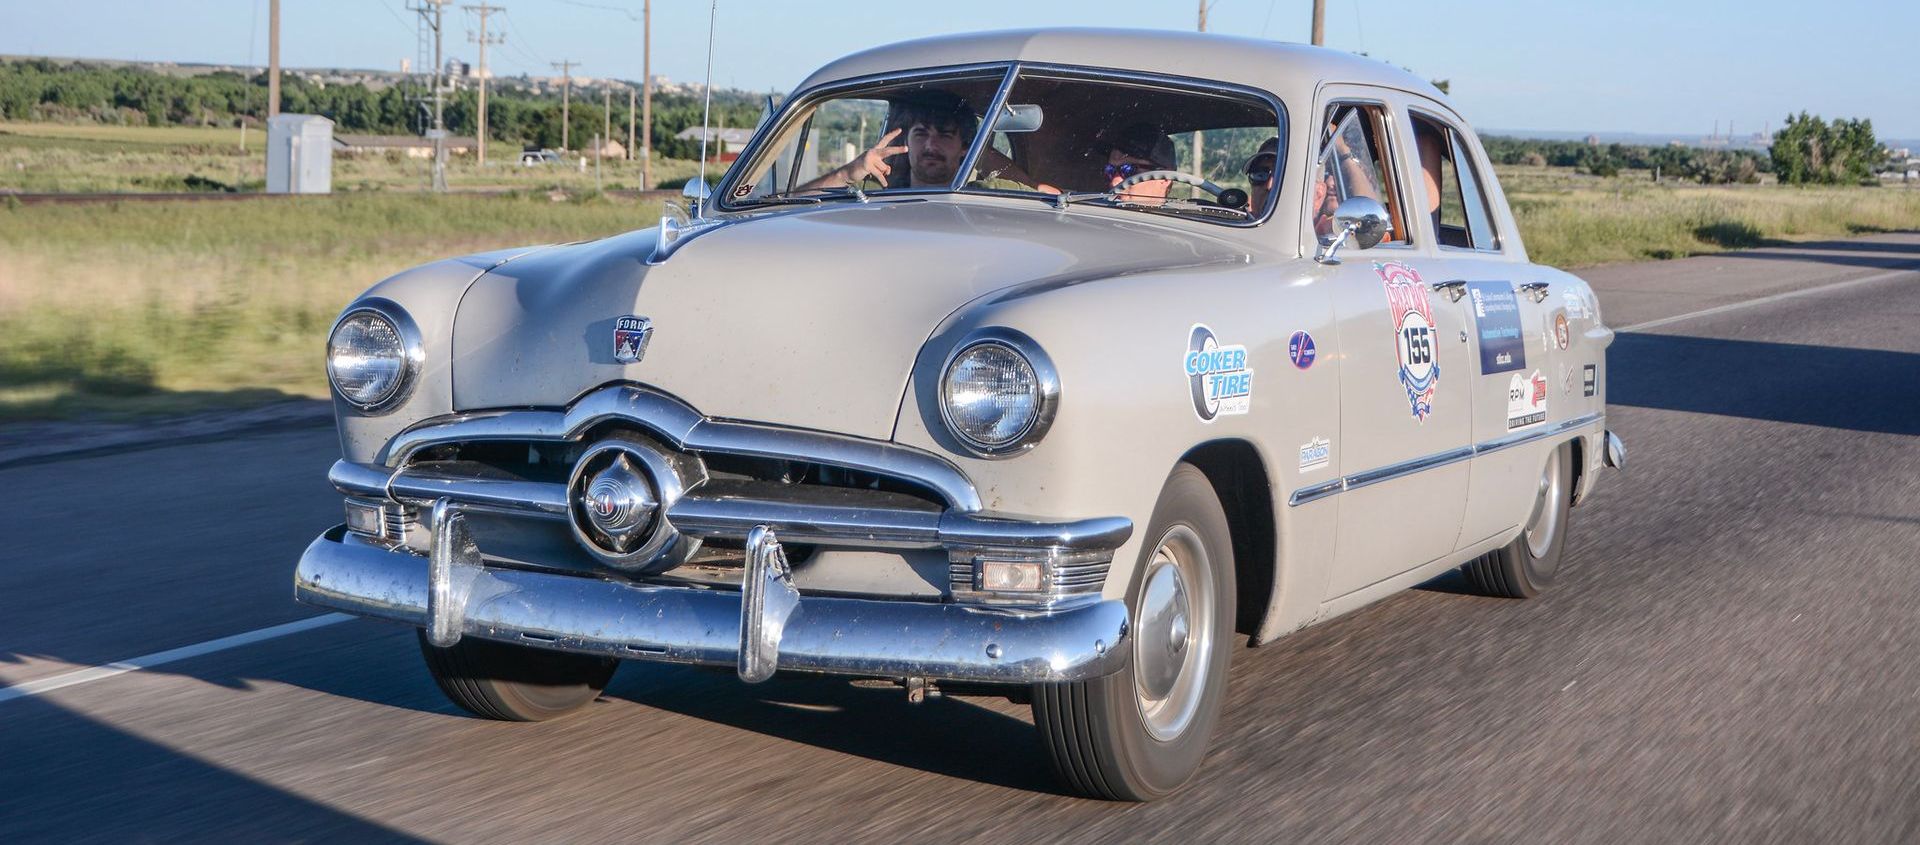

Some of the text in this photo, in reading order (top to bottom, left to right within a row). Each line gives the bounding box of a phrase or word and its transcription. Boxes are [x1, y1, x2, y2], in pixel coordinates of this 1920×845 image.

[619, 319, 645, 330] FORD
[1403, 327, 1431, 365] 155
[1186, 349, 1246, 374] COKER
[1209, 373, 1250, 399] TIRE
